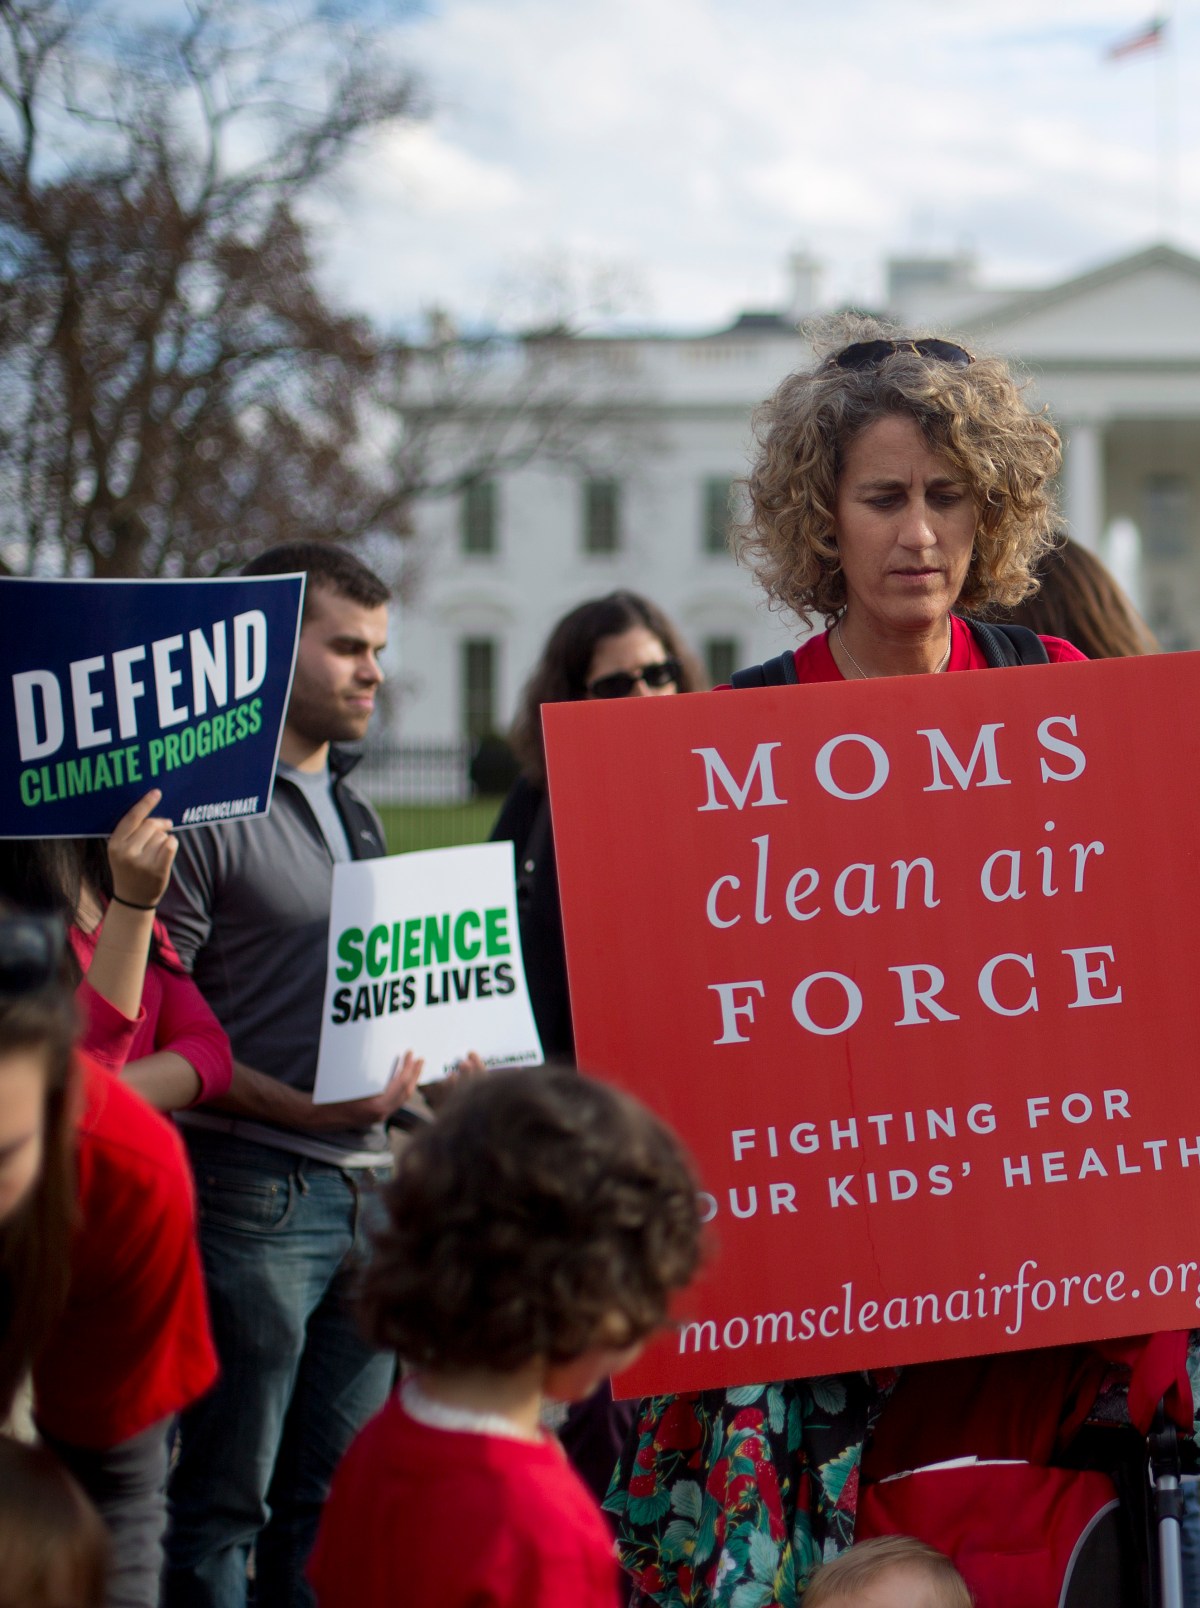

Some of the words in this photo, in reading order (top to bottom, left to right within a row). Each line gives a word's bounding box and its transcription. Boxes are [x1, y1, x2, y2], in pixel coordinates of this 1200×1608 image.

[12, 609, 267, 762] DEFEND
[19, 745, 142, 807] CLIMATE
[148, 698, 262, 777] PROGRESS
[691, 714, 1087, 811] MOMS
[706, 834, 941, 928] clean
[980, 820, 1104, 902] air
[336, 906, 511, 983] SCIENCE
[331, 976, 417, 1025] SAVES
[425, 963, 515, 1006] LIVES
[707, 945, 1122, 1044] FORCE
[731, 1103, 997, 1161] FIGHTING
[1027, 1088, 1130, 1128] FOR
